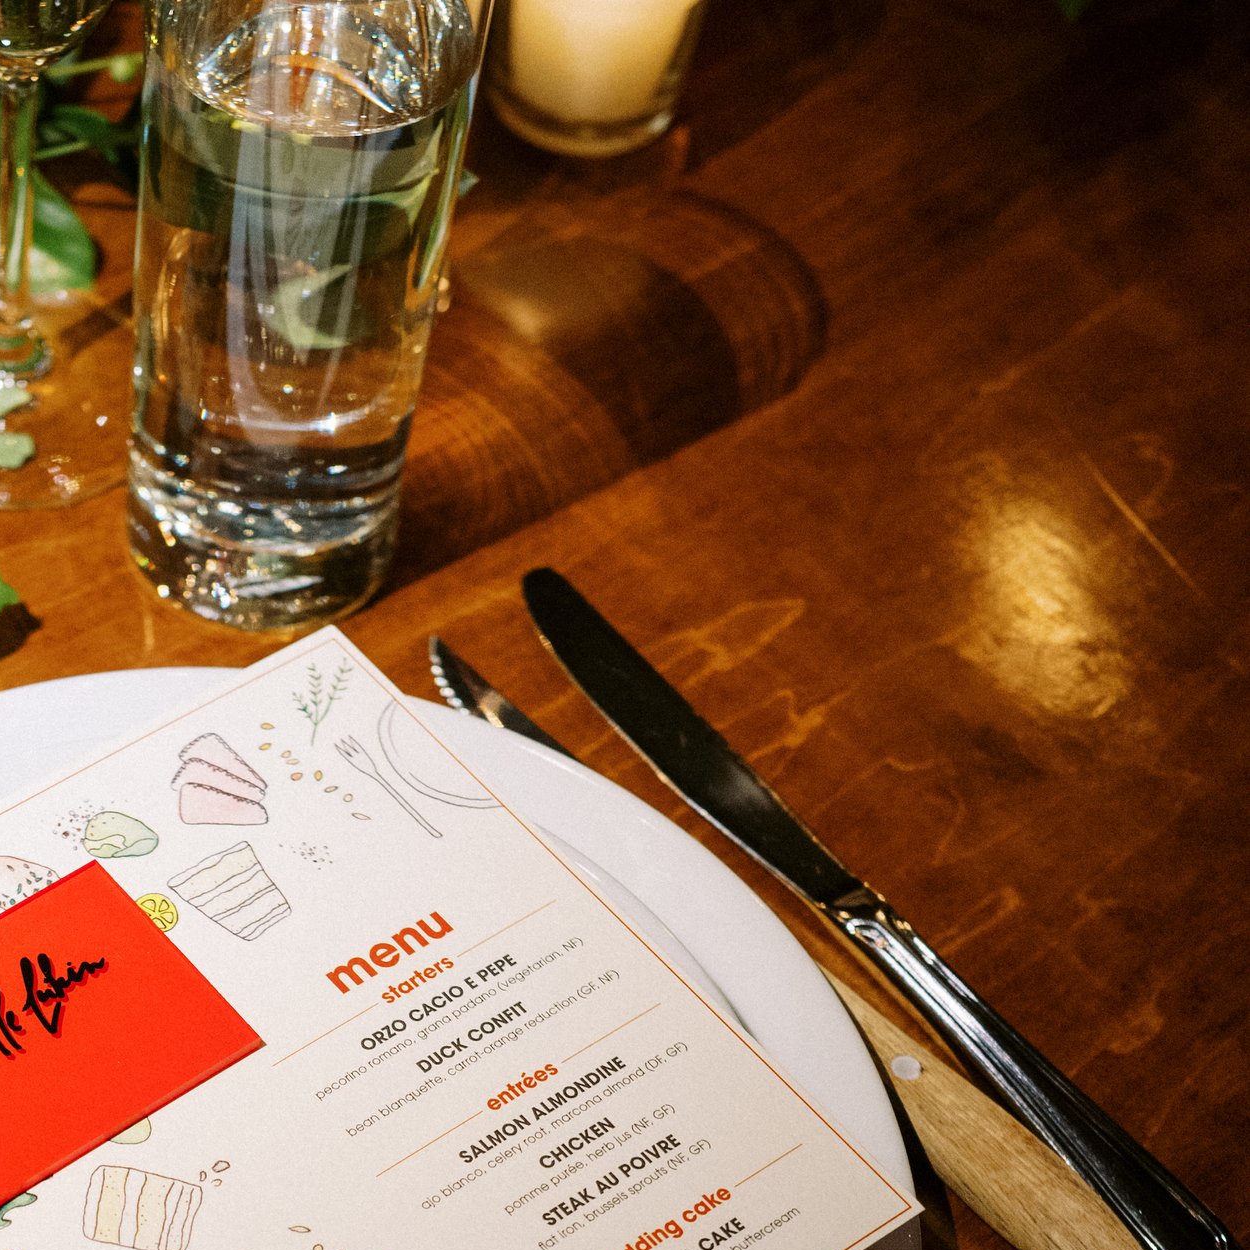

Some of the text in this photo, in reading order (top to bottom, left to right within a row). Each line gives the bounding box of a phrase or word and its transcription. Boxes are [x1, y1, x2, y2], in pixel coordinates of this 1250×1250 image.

[325, 911, 454, 995] menu
[381, 957, 455, 1004] starters
[314, 936, 584, 1102] pecorino romano, grana padano (vegetarian, NF)
[360, 953, 518, 1051] ORZO CACIO E PEPE
[415, 1000, 528, 1074] DUCK CONFIT
[345, 969, 621, 1138] bean blanquette, carrot-orange reduction (GF, NF)
[486, 1063, 559, 1111] entrées
[420, 1041, 689, 1210] ajo blanco, celery root, marcona almond (DF, GF)
[458, 1055, 627, 1164] SALMON ALMONDINE
[538, 1116, 616, 1169] CHICKEN
[503, 1103, 676, 1217] pomme purée, herb jus (NF, GF)
[541, 1133, 682, 1226] STEAK AU POIVRE
[557, 1221, 586, 1239] iron,
[582, 1191, 629, 1223] brussels
[627, 1166, 669, 1196] sprouts
[666, 1152, 690, 1171] (NF,
[688, 1138, 712, 1156] GF)
[681, 1187, 732, 1224] cake
